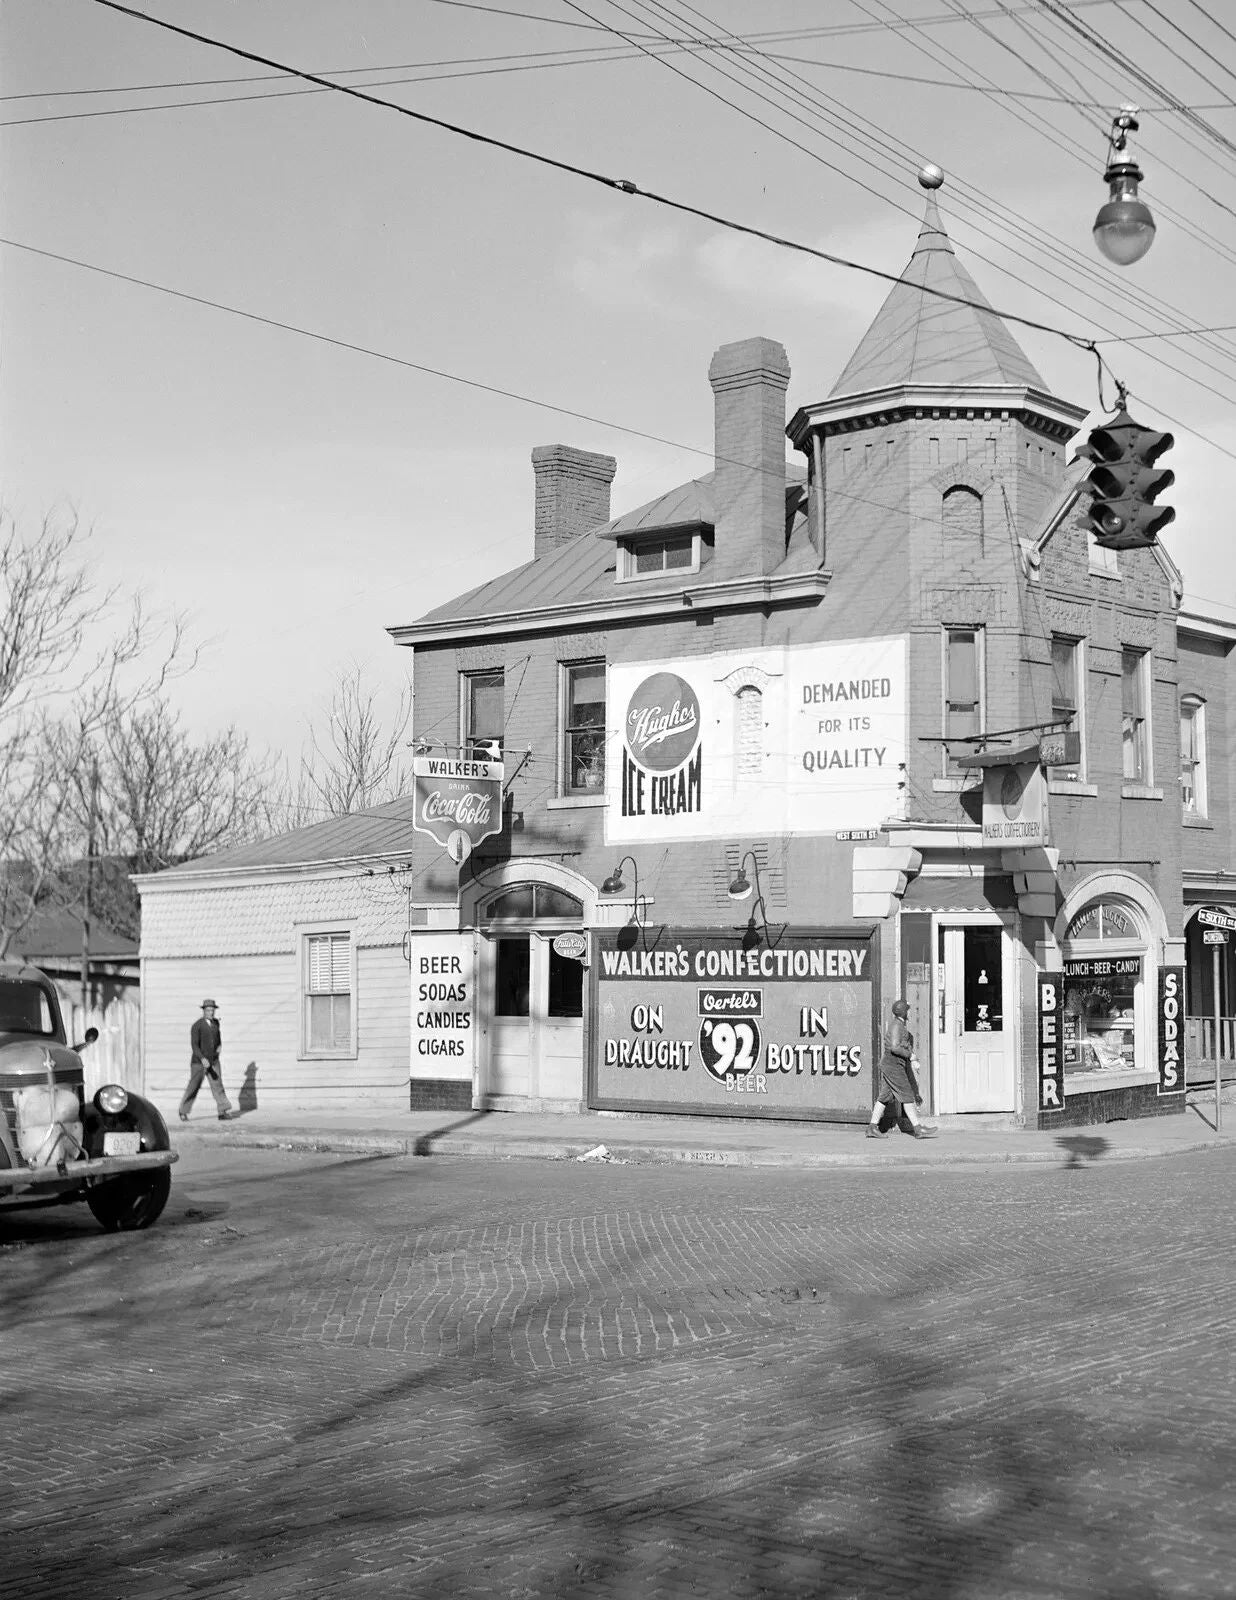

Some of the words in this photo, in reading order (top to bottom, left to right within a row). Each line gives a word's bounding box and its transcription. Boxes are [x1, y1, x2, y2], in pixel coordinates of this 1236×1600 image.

[803, 678, 891, 704] DEMANDED
[627, 700, 697, 751] Hughes
[818, 718, 841, 733] FOR
[849, 717, 871, 731] ITS
[428, 761, 489, 777] WALKER'S
[802, 747, 886, 772] QUALITY
[448, 783, 470, 791] DRINK
[622, 744, 646, 816] ICE
[651, 740, 702, 816] CREAM
[422, 791, 494, 825] Coca-Cola
[1205, 912, 1228, 926] SIXTH
[420, 956, 462, 974] BEER
[602, 945, 689, 976] WALKER'S
[695, 949, 867, 977] CONFECTIONERY
[1065, 962, 1089, 976] LUNCH
[1094, 961, 1111, 975] BEER
[1116, 960, 1139, 973] CANDY
[419, 983, 466, 1001] SODAS
[417, 1012, 470, 1029] CANDIES
[631, 1005, 663, 1033] ON
[800, 1007, 828, 1037] IN
[1163, 973, 1180, 1087] SODAS
[418, 1039, 464, 1056] CIGARS
[605, 1039, 693, 1071] DRAUGHT
[703, 1020, 754, 1076] '92
[1041, 983, 1060, 1106] BEER
[765, 1043, 862, 1076] BOTTLES
[726, 1072, 768, 1093] BEER
